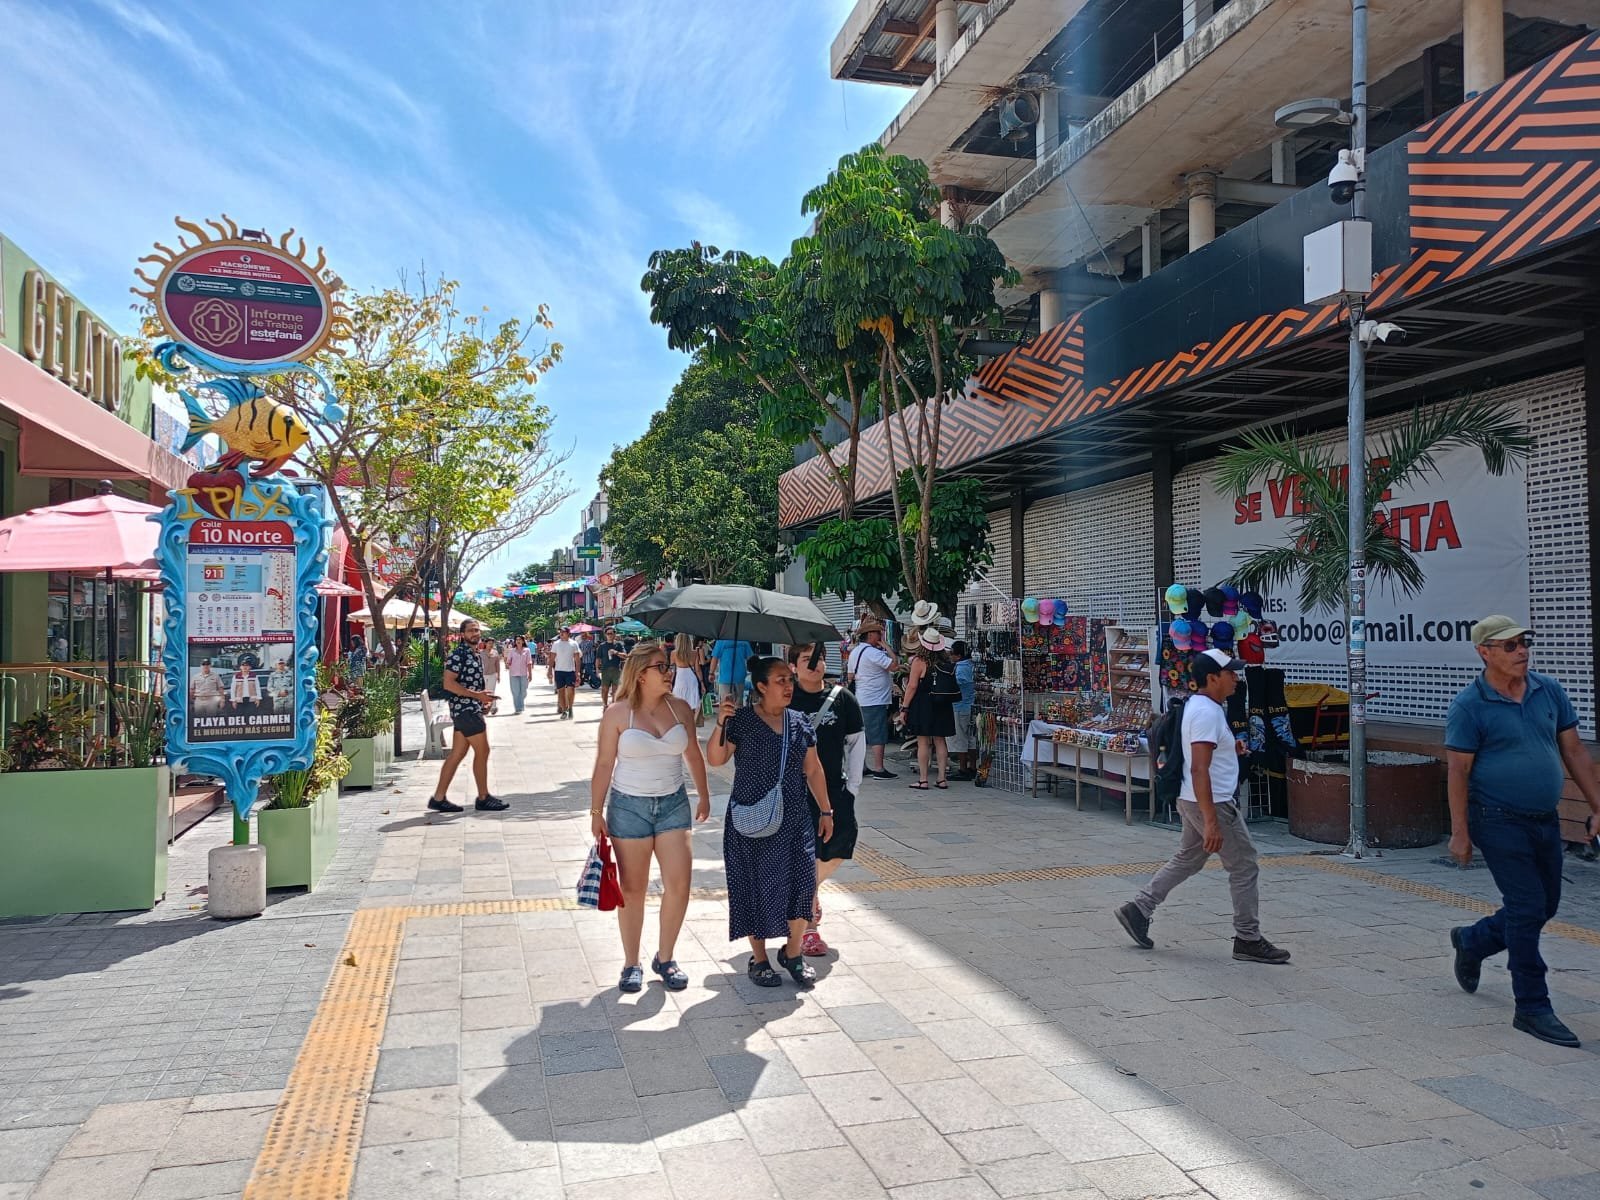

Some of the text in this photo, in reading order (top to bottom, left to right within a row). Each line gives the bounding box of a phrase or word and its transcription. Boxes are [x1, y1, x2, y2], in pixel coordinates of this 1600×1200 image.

[210, 313, 220, 332] 1
[250, 308, 303, 322] Informe
[250, 319, 303, 331] de Trabajo
[23, 269, 121, 412] GELATO
[176, 487, 203, 519] I
[1234, 491, 1262, 525] SE
[200, 529, 282, 544] 10 Norte
[205, 569, 224, 579] 911
[1279, 614, 1478, 645] cobo@mail.com
[193, 714, 291, 727] PLAYA DEL CARMEN
[193, 729, 202, 737] EL
[203, 727, 244, 736] MUNICIPIO
[262, 725, 291, 733] SEGURO
